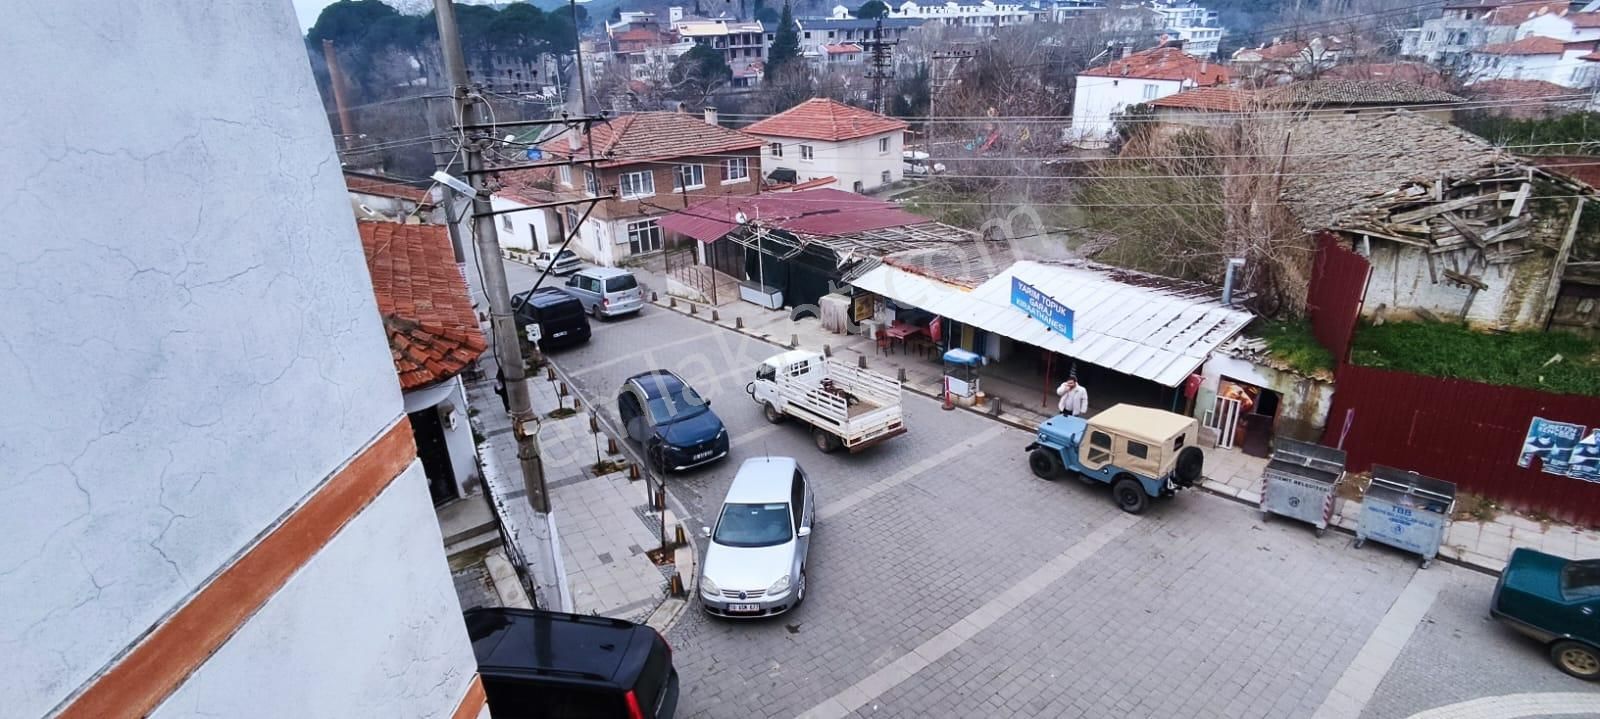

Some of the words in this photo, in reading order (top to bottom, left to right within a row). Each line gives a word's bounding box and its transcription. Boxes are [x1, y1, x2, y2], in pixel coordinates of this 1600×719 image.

[1017, 282, 1040, 302] YARIM
[1042, 295, 1067, 317] TOPUK
[1029, 298, 1053, 317] GARAJ
